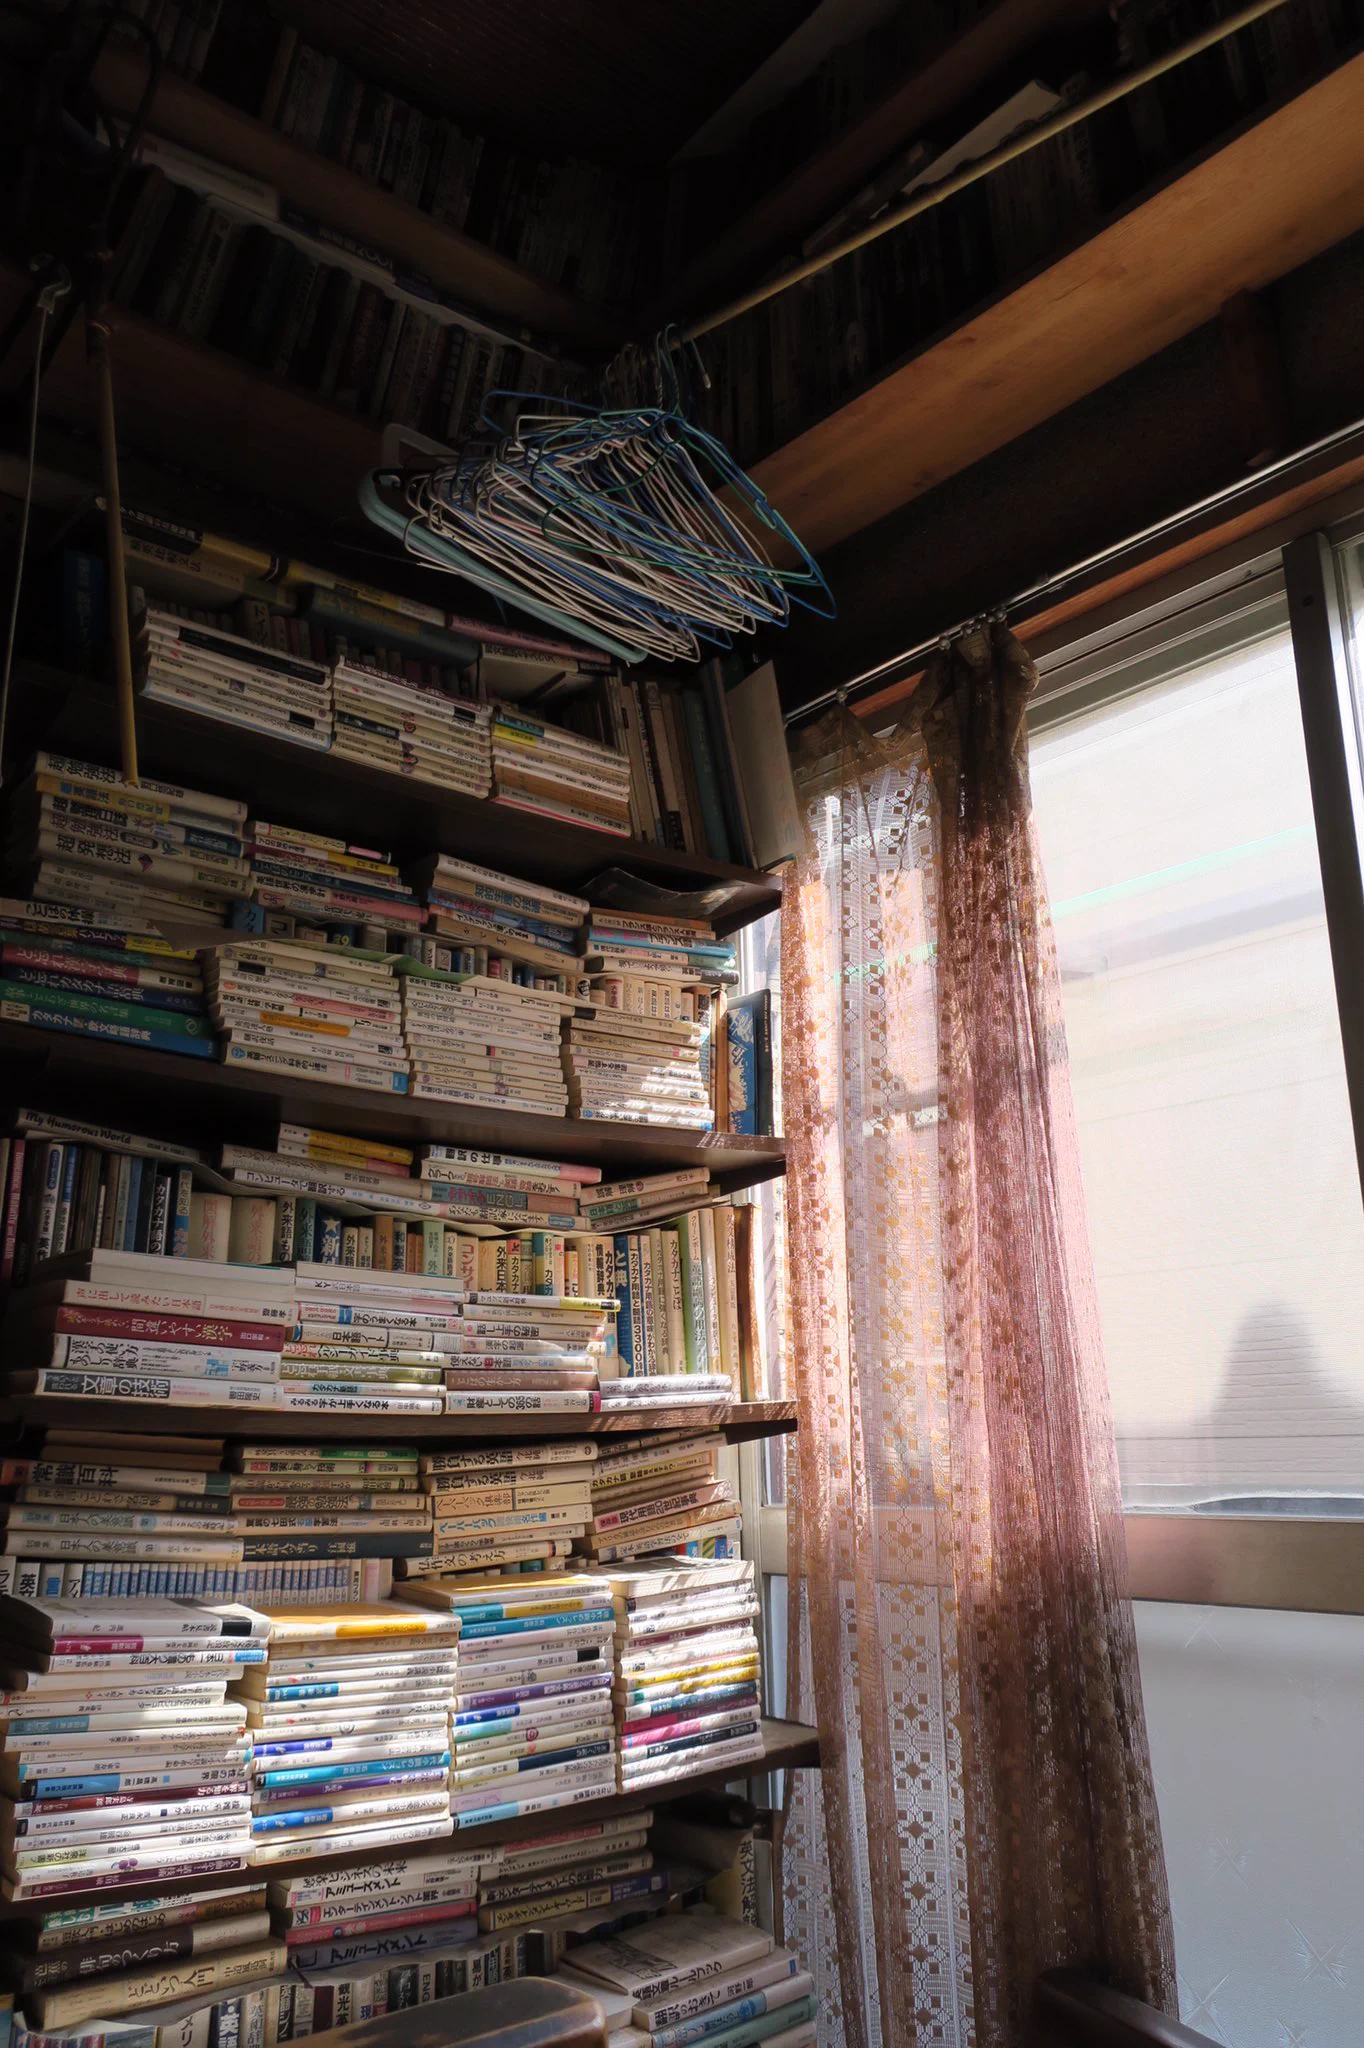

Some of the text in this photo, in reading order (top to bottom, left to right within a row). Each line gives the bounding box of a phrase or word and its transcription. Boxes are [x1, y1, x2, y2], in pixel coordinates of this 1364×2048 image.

[55, 835, 131, 865] 超発想法
[25, 1111, 131, 1145] My Humorous World
[445, 1149, 502, 1167] 翻訳の仕事
[246, 1171, 346, 1196] コンピュータで翻訳する
[75, 1288, 201, 1310] 声に出して読みたい日本語
[129, 1320, 232, 1340] 間違いやすい漢字
[353, 1313, 417, 1328] 字のうまくなる本
[476, 1322, 539, 1338] 話し上手の秘密
[332, 1332, 384, 1344] 日本語ノート
[69, 1357, 140, 1369] ものしり辞典
[449, 1356, 512, 1368] 使えない日本語
[81, 1376, 170, 1397] 文章の技術
[290, 1397, 389, 1411] みるみる字が上手くなる本
[466, 1397, 541, 1411] 財産としての365の話
[432, 1450, 512, 1469] 勝負する英語
[31, 1465, 118, 1486] 常識百科
[436, 1472, 517, 1492] 勝負する英語
[436, 1493, 511, 1511] ペーパーバック倶楽部
[619, 1491, 698, 1524] 現代用語20世紀事典
[244, 1543, 319, 1556] 日本語八ツ当り
[417, 1548, 507, 1570] 仏作文の考え方
[325, 1878, 401, 1898] アミューズメント
[79, 1941, 179, 1974] 俳句のつくり方
[329, 1933, 427, 1963] アミューズメント
[128, 1969, 215, 2001] どどいつ入門
